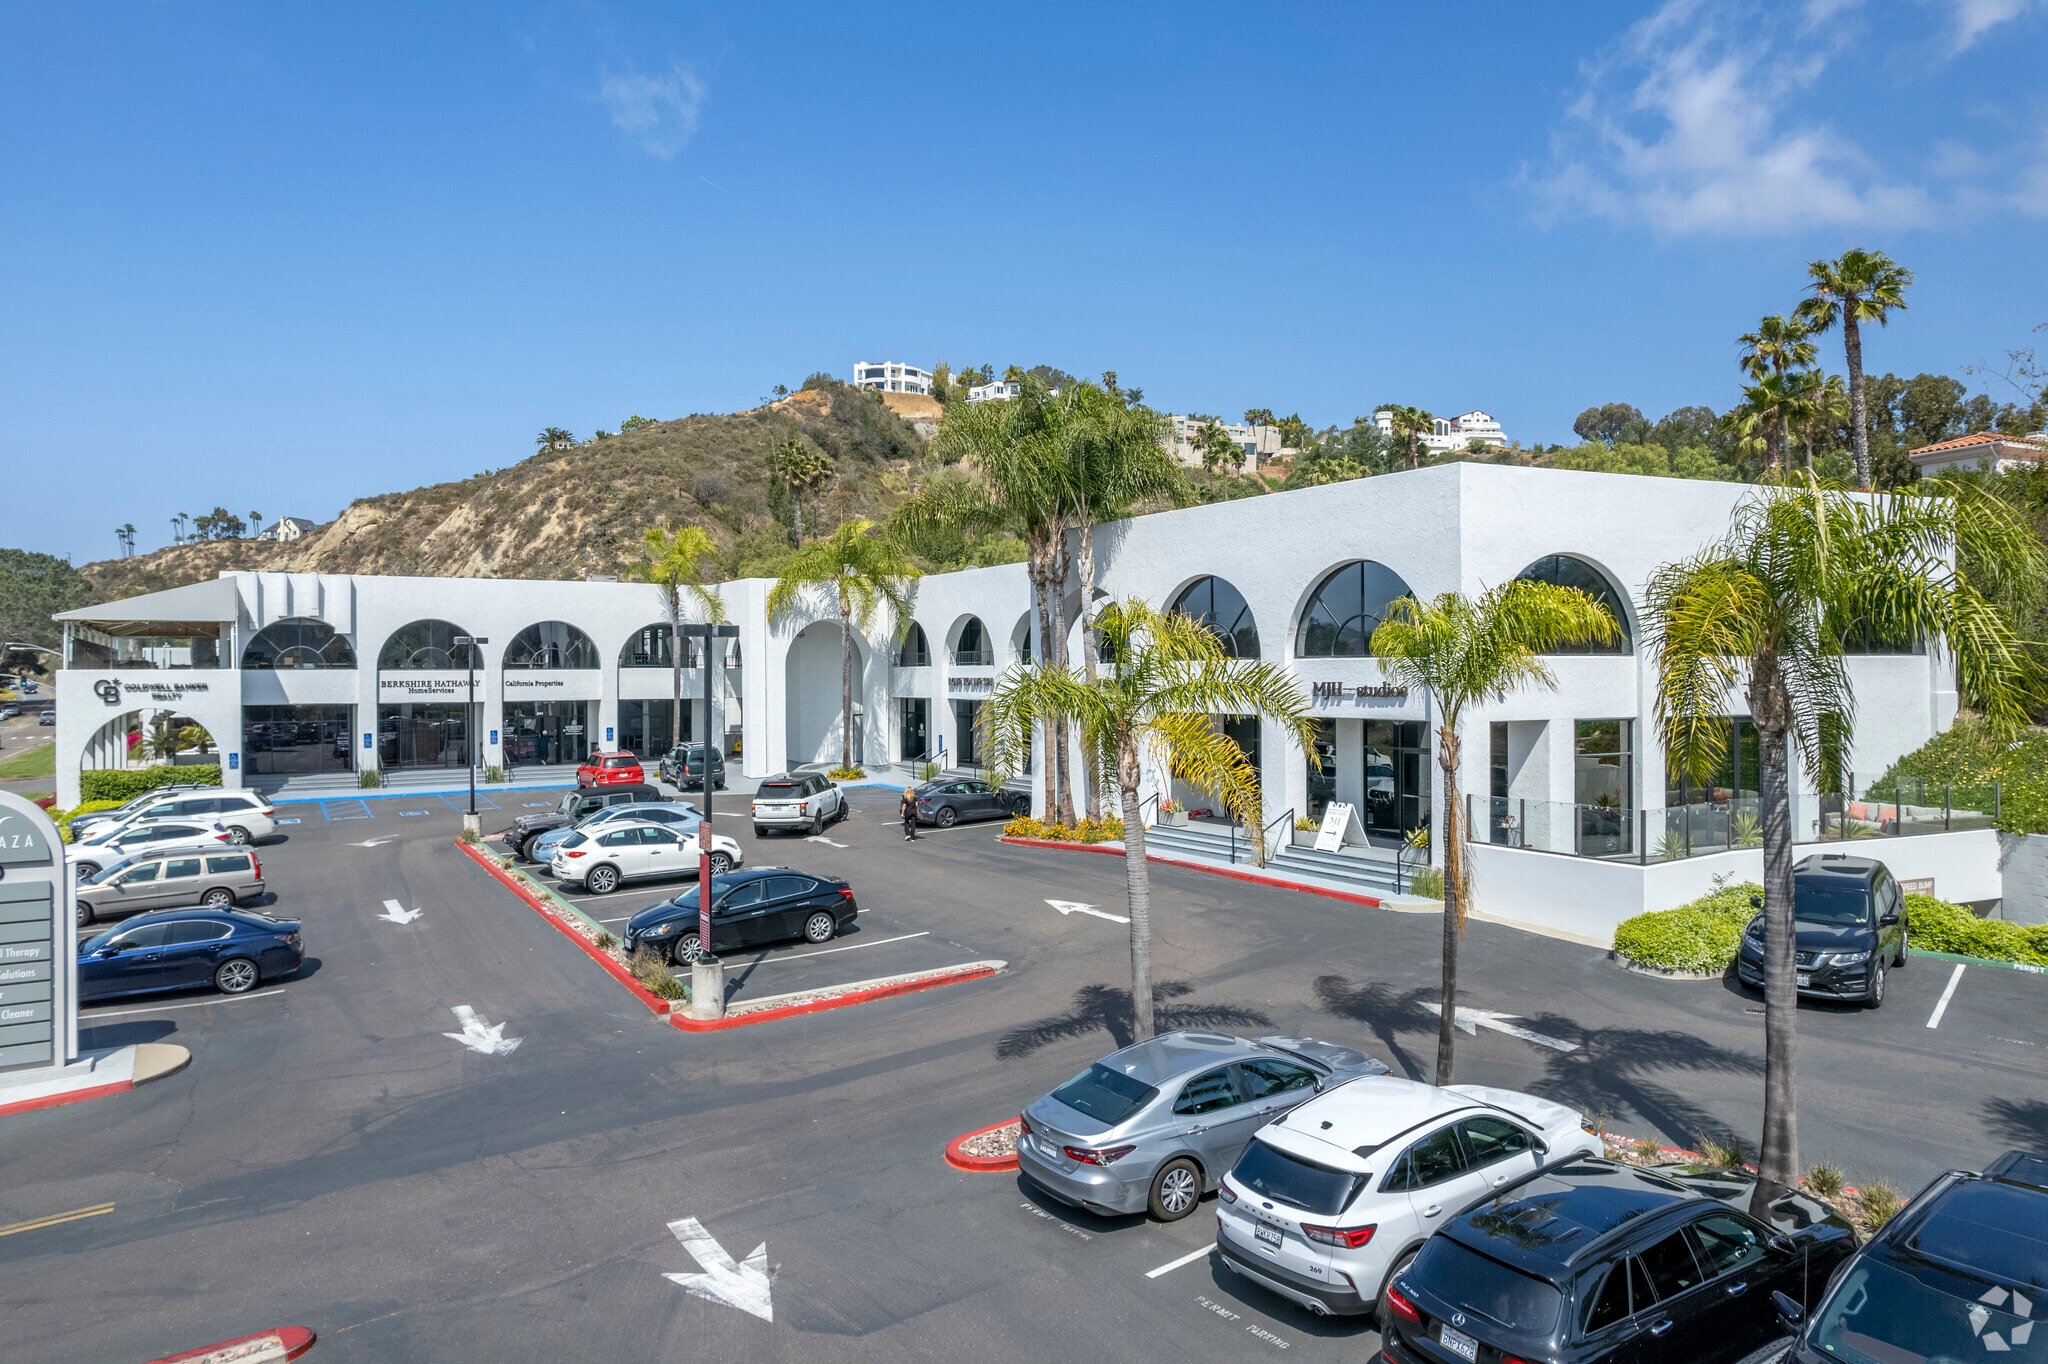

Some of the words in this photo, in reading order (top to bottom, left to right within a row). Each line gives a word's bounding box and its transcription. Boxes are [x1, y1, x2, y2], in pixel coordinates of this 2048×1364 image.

[124, 683, 171, 691] COLDWELL
[173, 683, 209, 691] BANKER
[381, 680, 432, 688] BERKSHIRE
[151, 692, 182, 700] REALTY
[1919, 880, 1933, 889] BUMP
[5, 947, 40, 958] Therapy
[2013, 963, 2046, 974] PERMIT
[1, 1009, 34, 1019] Cleaner
[1020, 1202, 1055, 1220] PERMIT
[1309, 1265, 1322, 1274] 269
[1194, 1296, 1240, 1321] PERMIT
[1246, 1324, 1289, 1350] PARKING
